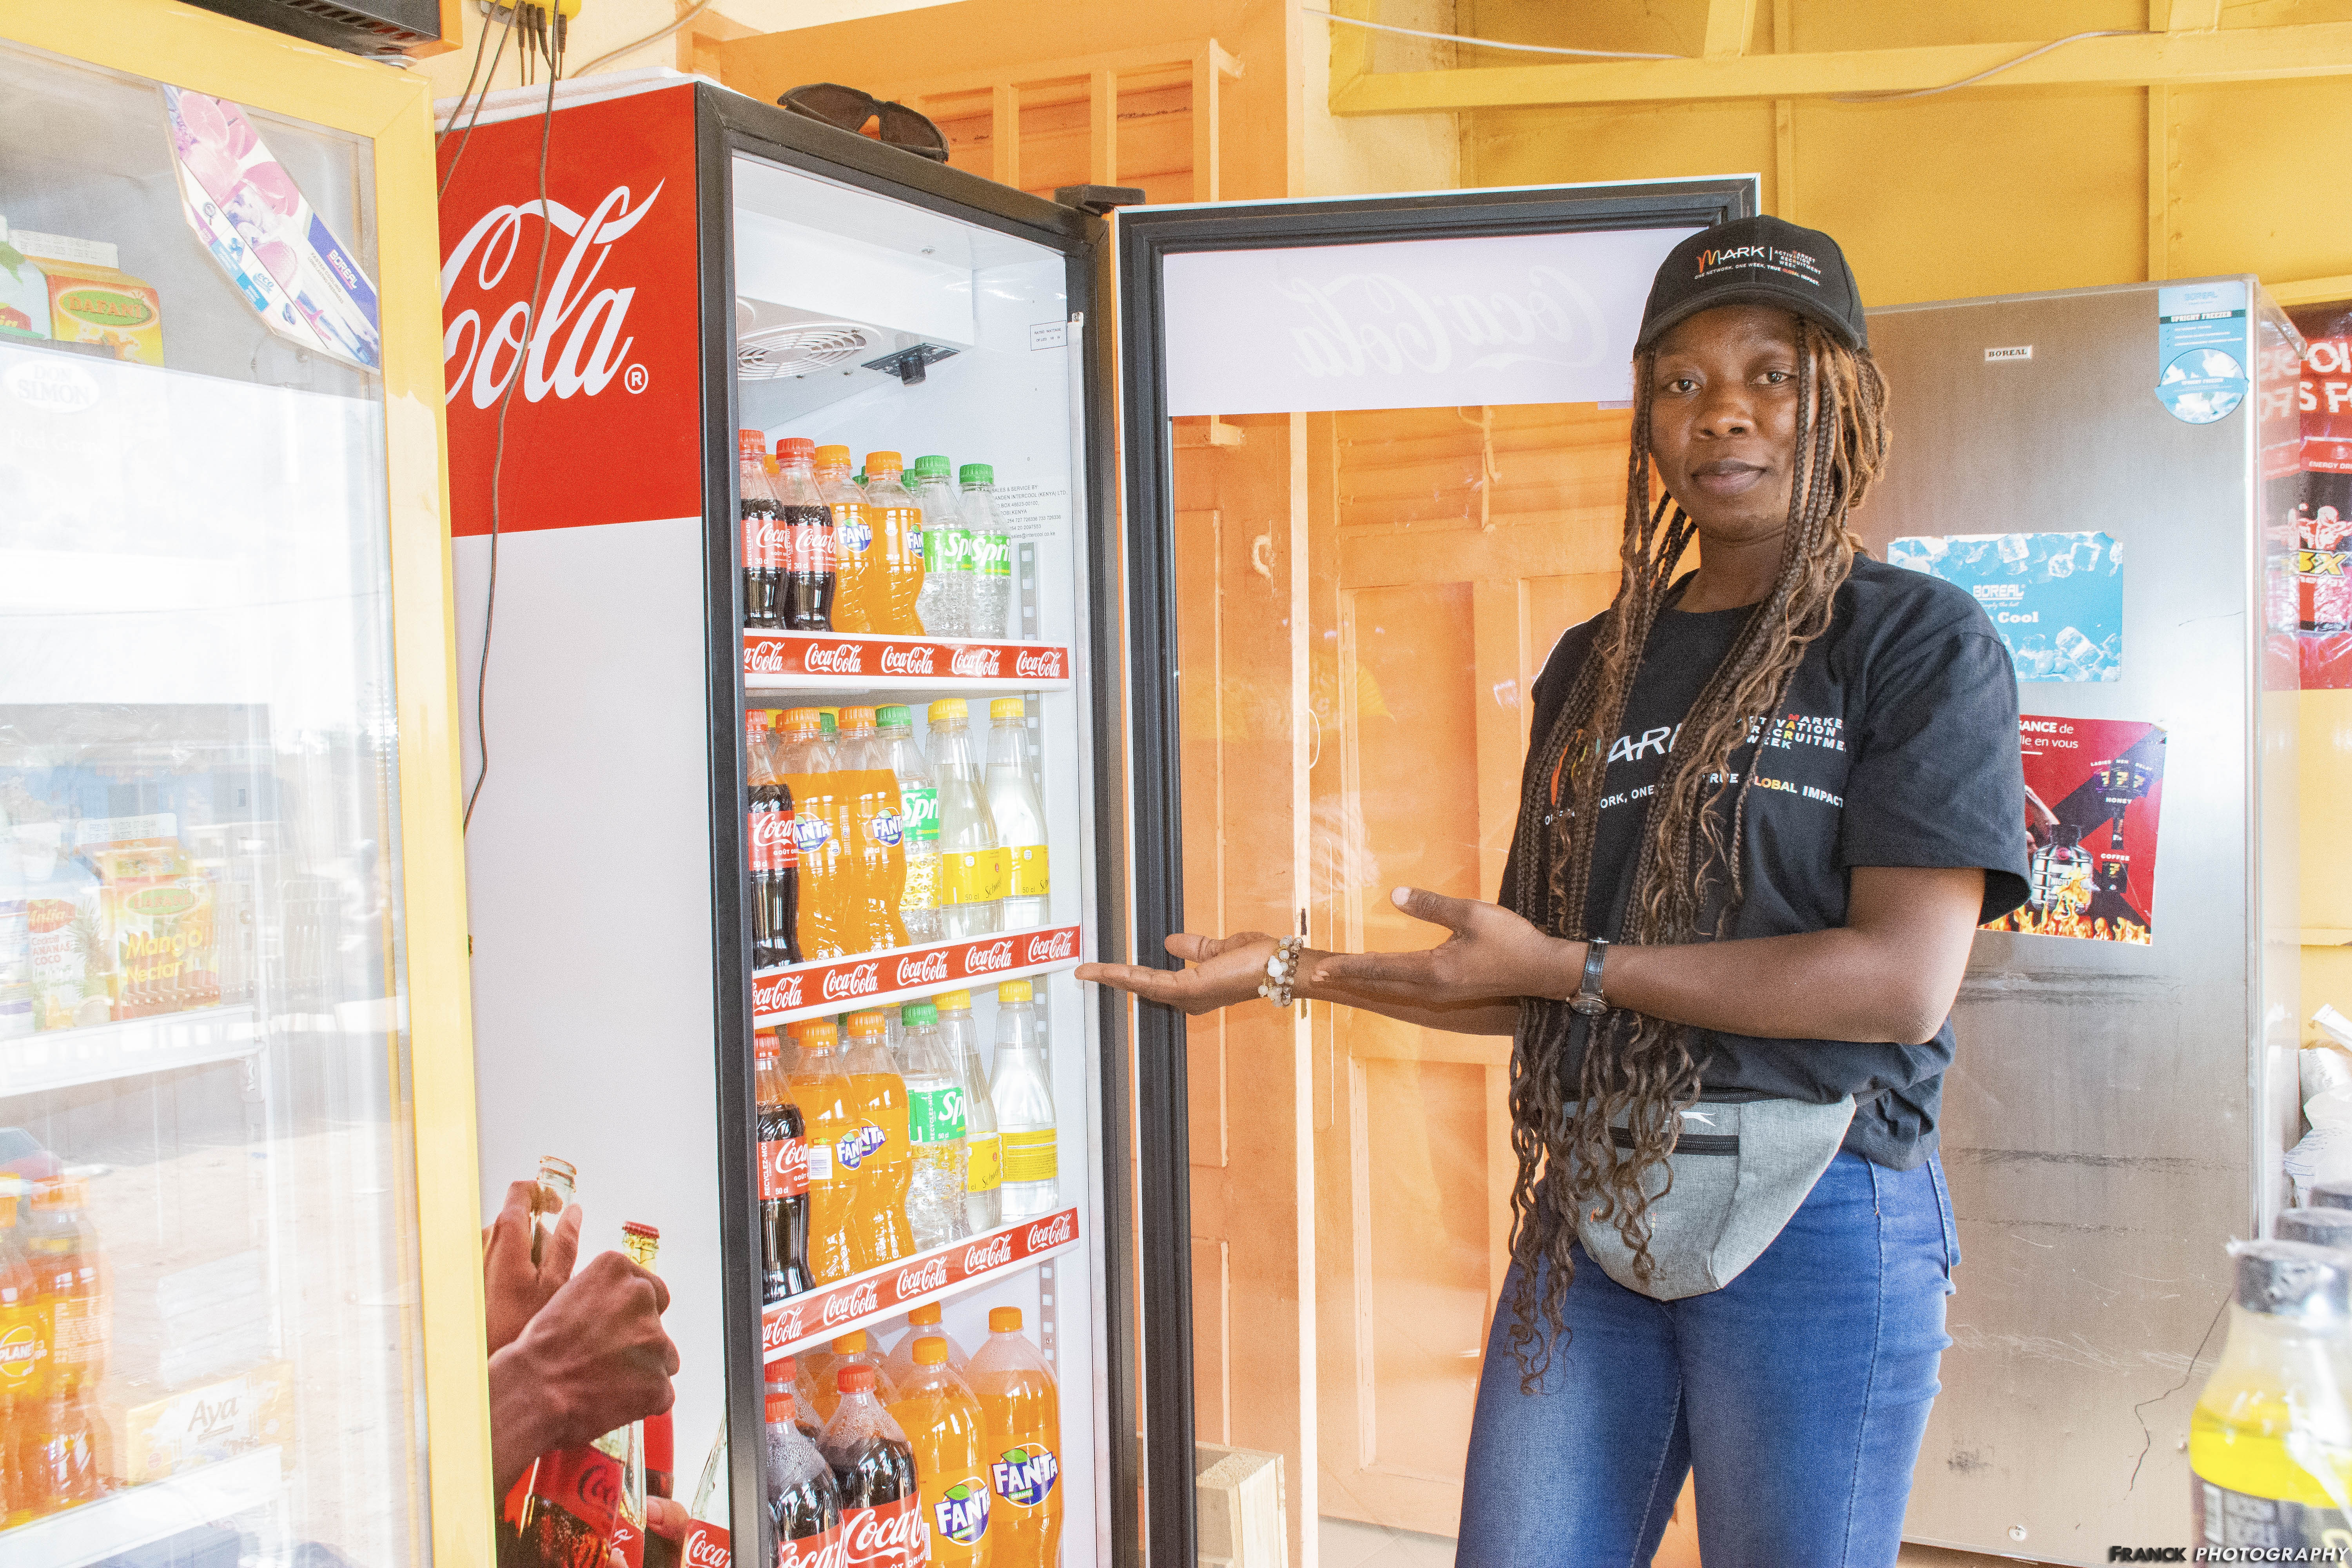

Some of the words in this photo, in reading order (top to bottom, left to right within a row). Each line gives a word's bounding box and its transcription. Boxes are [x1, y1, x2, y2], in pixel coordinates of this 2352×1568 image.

[1696, 246, 1764, 273] MARK
[1775, 250, 1810, 265] ACTIVATION
[1779, 260, 1796, 269] WEEK
[1780, 256, 1821, 275] RECRUITMENT
[1792, 250, 1815, 263] MARKET
[329, 249, 358, 289] BOREAL
[68, 296, 143, 319] DAFANI
[2202, 311, 2231, 319] FREEZER
[1988, 348, 2027, 358] BOREAL
[34, 364, 72, 382] DON
[17, 379, 90, 405] SIMON
[2309, 461, 2338, 469] ENERGY
[795, 528, 836, 554] Coca-C
[837, 523, 872, 543] FANTA
[906, 531, 923, 549] FAN
[972, 537, 1011, 566] Spri
[1973, 584, 2025, 598] BOREAL
[1998, 611, 2039, 624] Cool
[744, 641, 785, 671] a-Cola
[805, 643, 862, 673] Coca-Cola
[881, 646, 935, 674] Coca-Cola
[951, 648, 1001, 676] Coca-Cola
[1016, 650, 1062, 677] Coca-Cola
[1788, 713, 1843, 729] MARKE
[2059, 724, 2074, 734] de
[1751, 725, 1846, 752] RCRUITME
[2051, 739, 2078, 749] vous
[1631, 785, 1655, 799] ONE
[1754, 776, 1798, 793] LOBAL
[871, 815, 903, 838] FANT
[2100, 853, 2130, 861] COFFEE
[133, 893, 189, 909] DAFANI
[33, 941, 71, 956] ANANAS
[126, 929, 203, 959] Mango
[34, 954, 61, 966] COCO
[126, 960, 183, 984] Nectar
[753, 975, 803, 1012] oca-Cola
[823, 962, 879, 1000] Coca-Cola
[897, 951, 949, 986] Coca-Cola
[965, 940, 1014, 974] Coca-Cola
[1028, 931, 1075, 962] Coca-Cola
[761, 1142, 771, 1196] RECYCLEZ-MOI
[784, 1186, 789, 1194] cl
[762, 1306, 804, 1350] a-Cola
[823, 1279, 878, 1326] Coca-Cola
[896, 1256, 947, 1299] Coca-Cola
[964, 1233, 1013, 1275] Coca-Cola
[1027, 1213, 1073, 1252] Coca-Cola
[187, 1395, 241, 1433] Aya
[993, 1452, 1058, 1493] FANTA
[1011, 1490, 1033, 1499] ORANGE
[935, 1486, 991, 1534] FANTA
[845, 1491, 923, 1564] Coca-C
[953, 1527, 975, 1539] ORANGE
